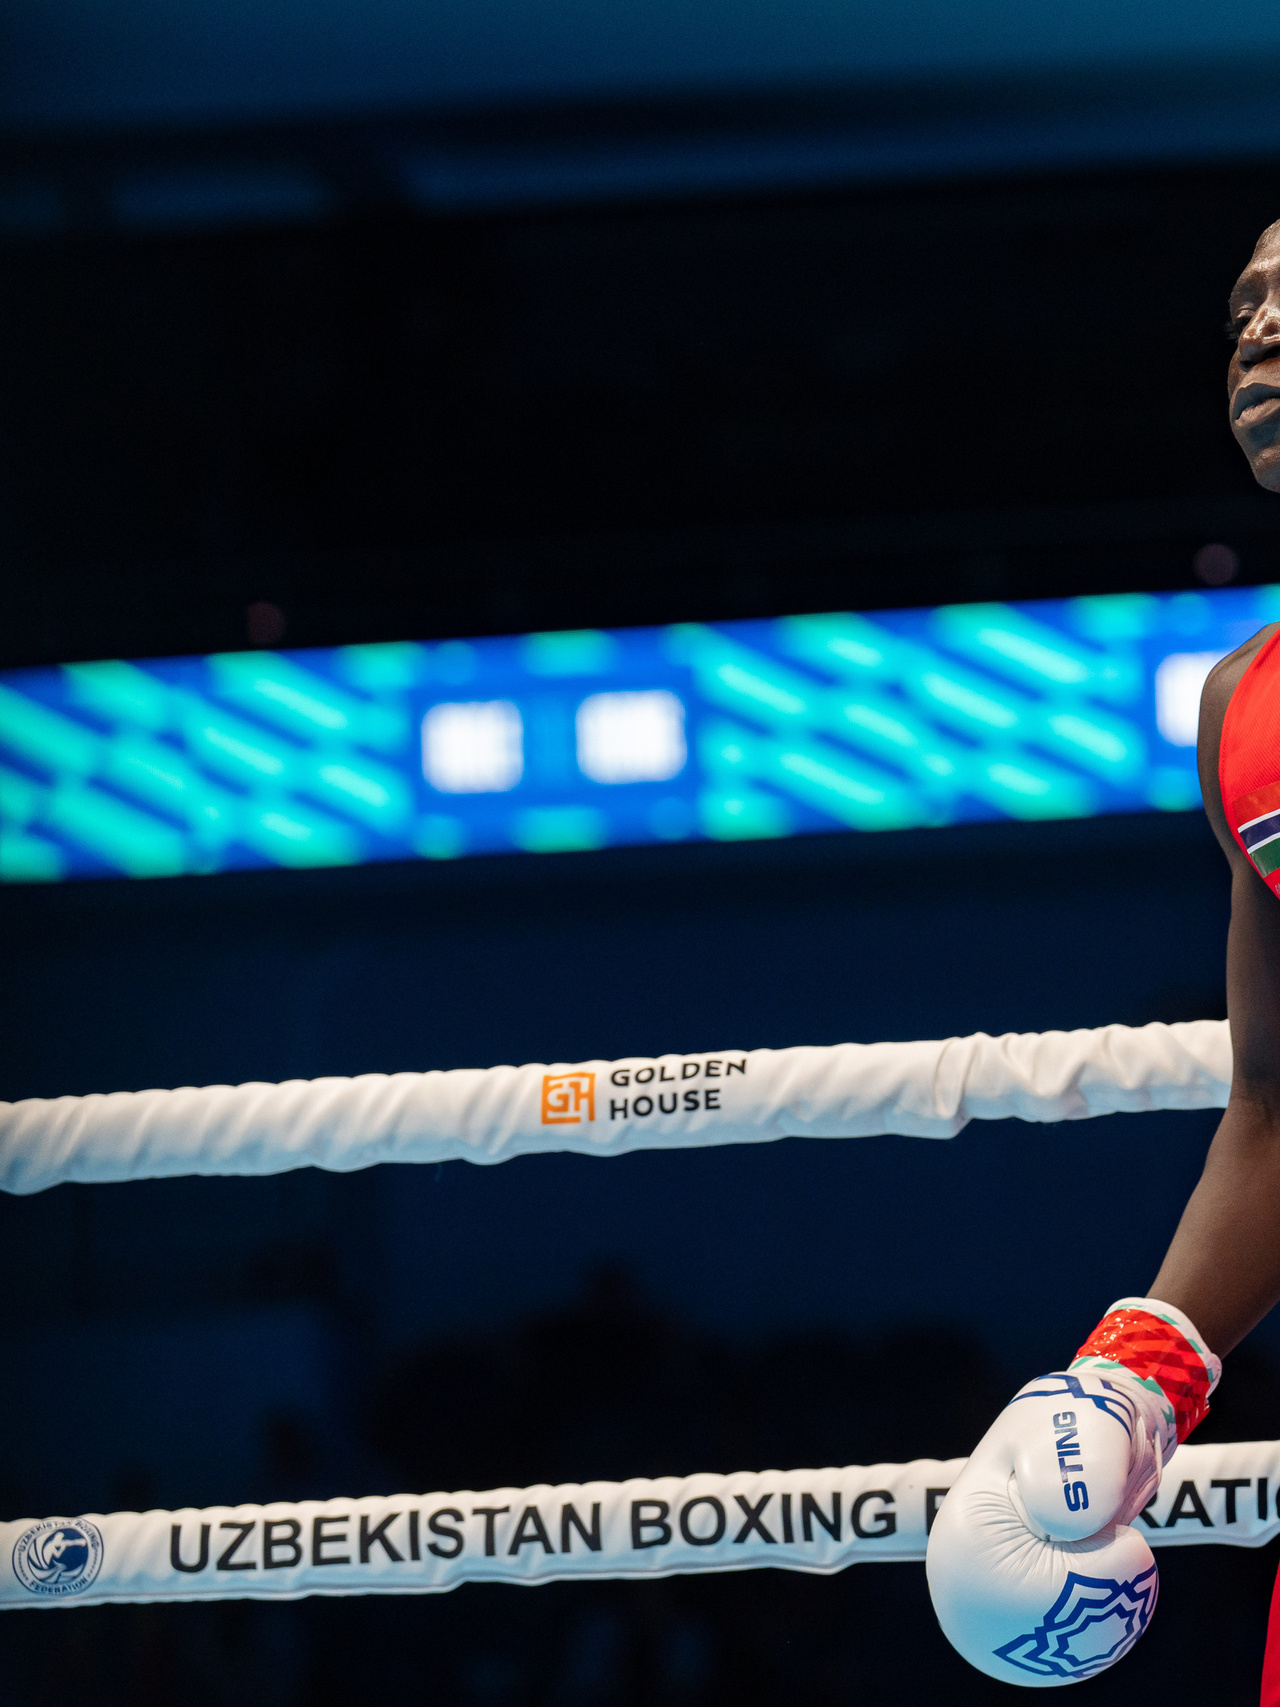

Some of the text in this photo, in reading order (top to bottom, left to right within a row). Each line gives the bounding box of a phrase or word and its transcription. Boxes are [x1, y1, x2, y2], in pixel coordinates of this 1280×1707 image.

[610, 1059, 747, 1087] GOLDEN
[609, 1089, 721, 1120] HOUSE
[1053, 1411, 1090, 1512] STING
[170, 1502, 603, 1574] UZBEKISTAN
[631, 1490, 897, 1549] BOXING
